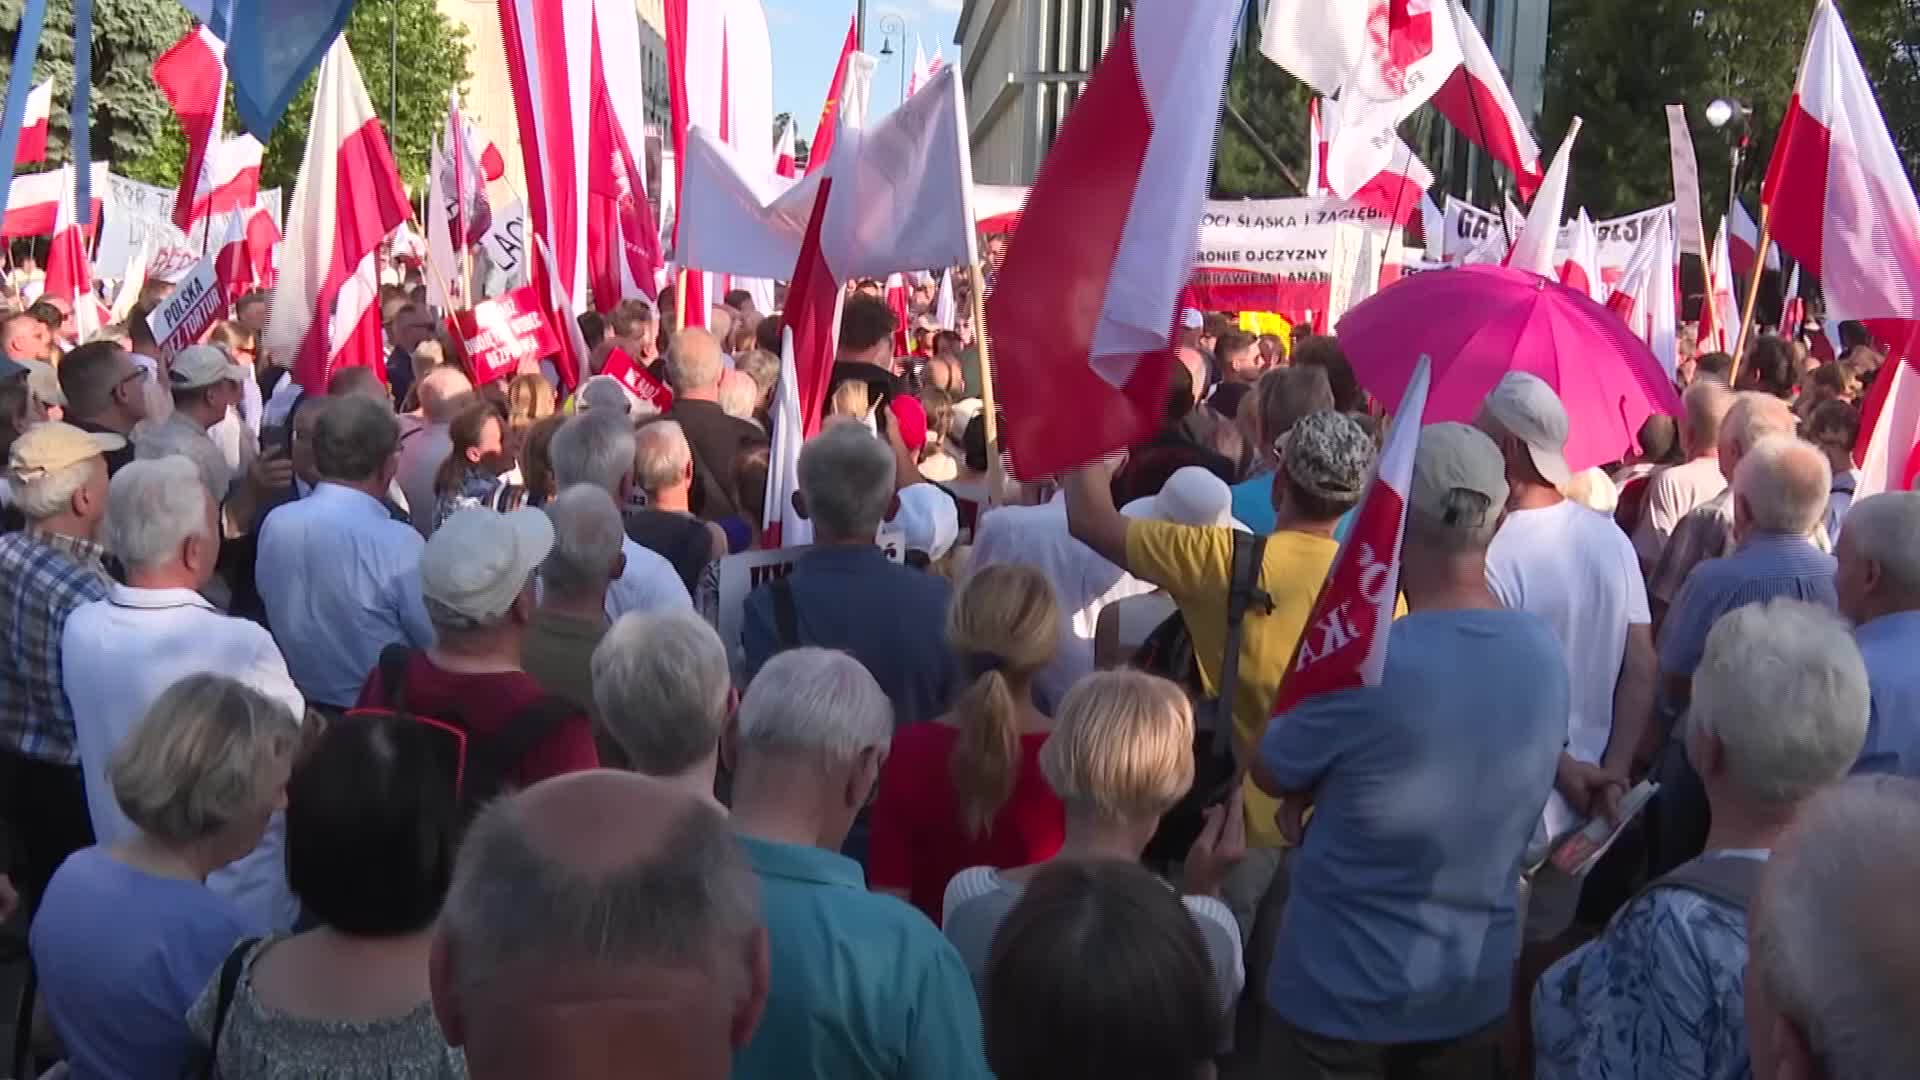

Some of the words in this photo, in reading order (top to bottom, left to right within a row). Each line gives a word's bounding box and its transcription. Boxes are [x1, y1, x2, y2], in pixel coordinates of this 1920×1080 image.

[1193, 250, 1240, 263] RONIE
[1246, 248, 1328, 262] OJCZYZNY
[164, 276, 204, 330] POLSKA
